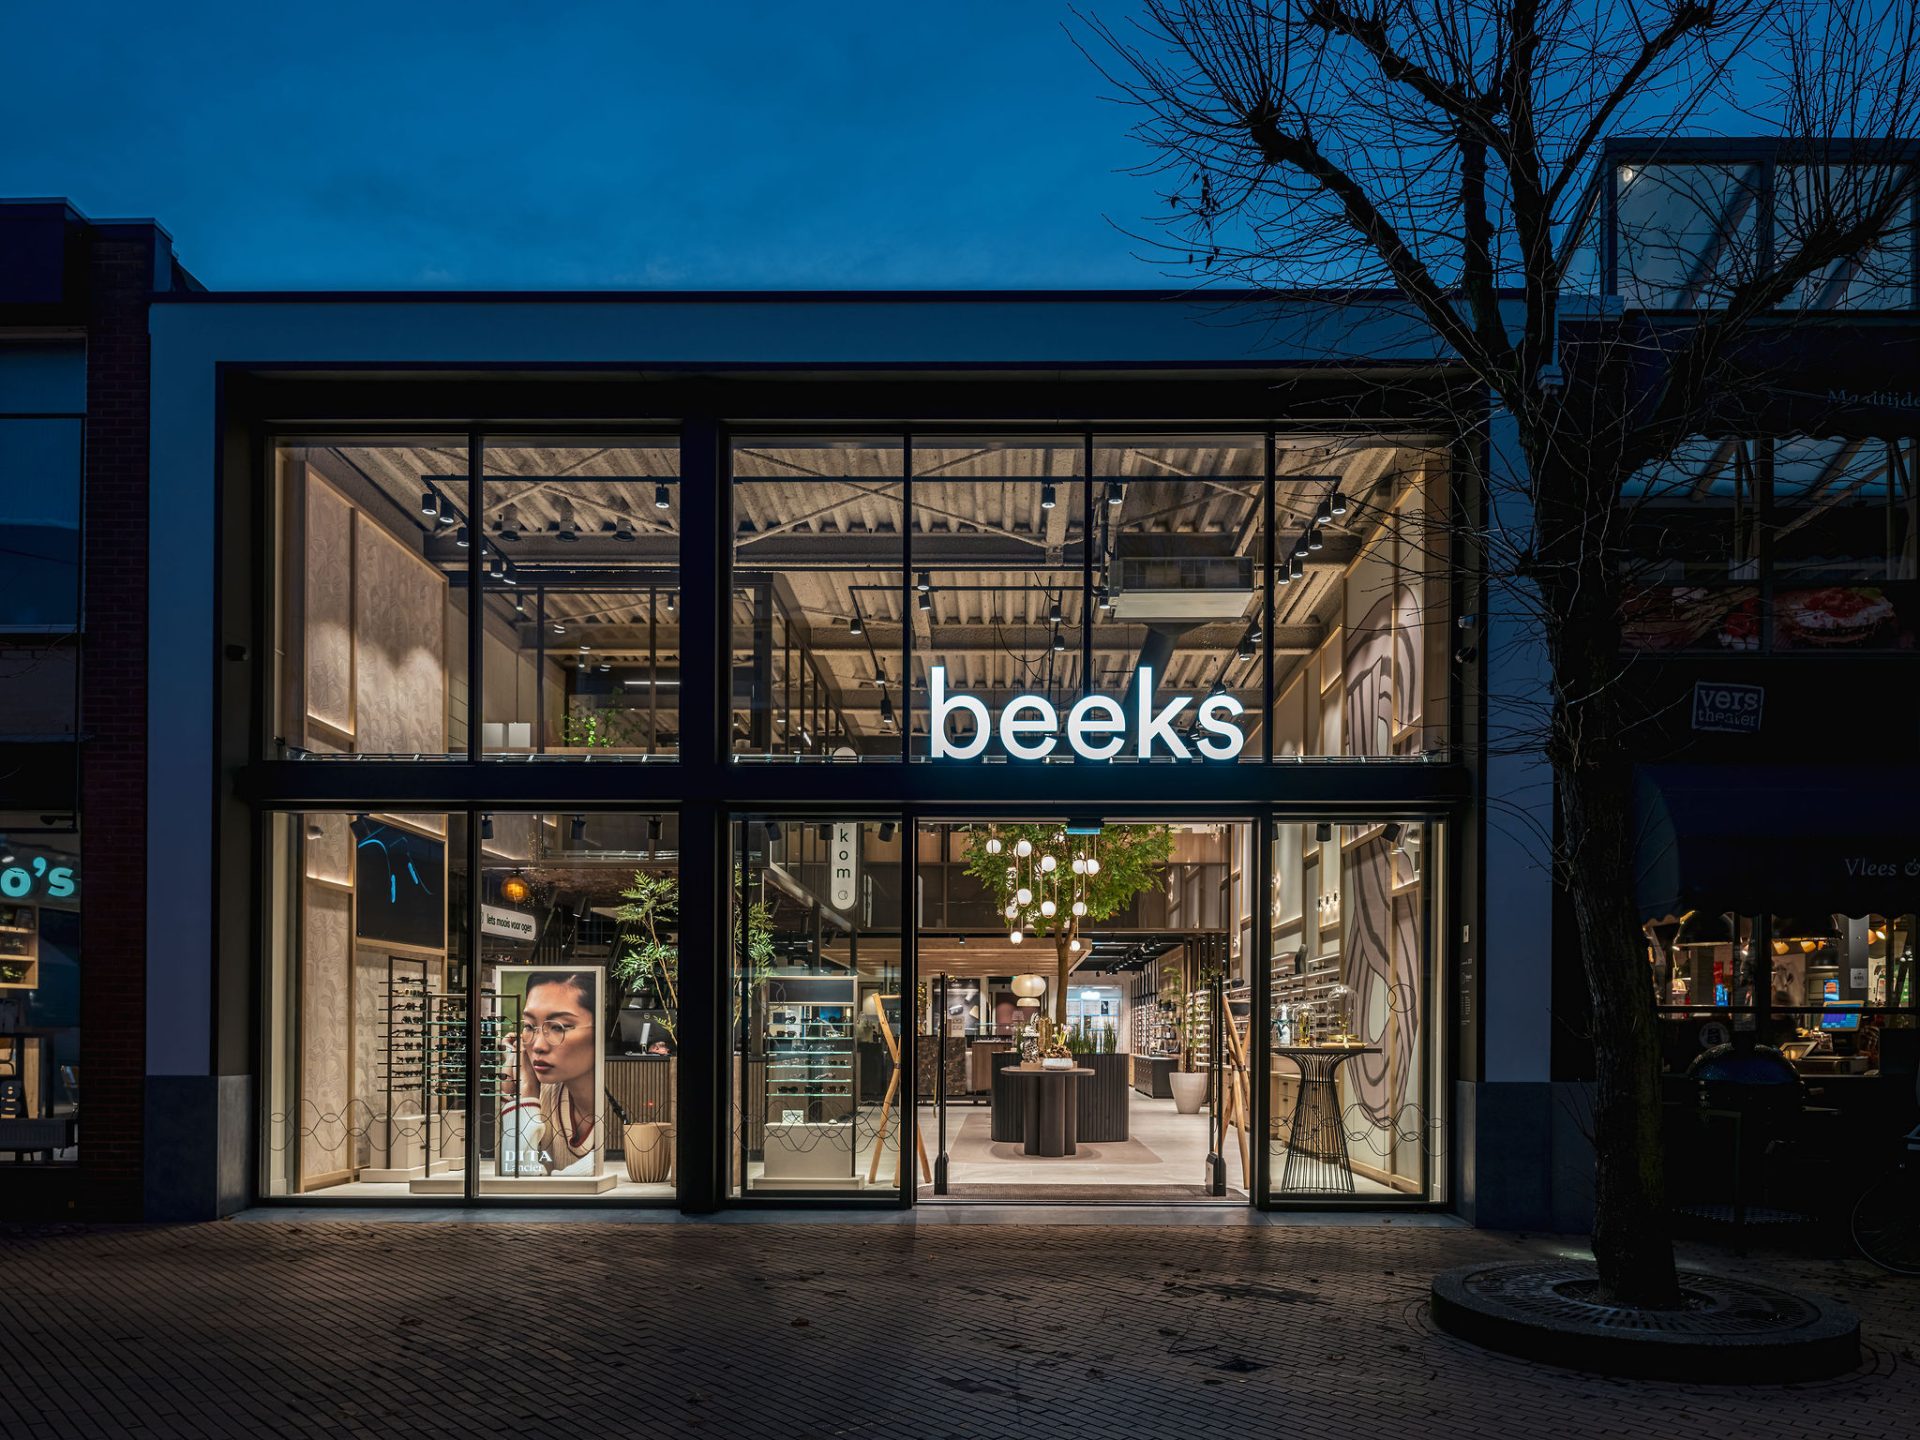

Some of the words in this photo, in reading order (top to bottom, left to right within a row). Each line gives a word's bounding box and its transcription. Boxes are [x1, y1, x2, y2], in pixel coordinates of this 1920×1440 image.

[1699, 690, 1759, 711] vers
[931, 666, 1245, 760] beeks
[1844, 858, 1897, 876] Vlees
[505, 1150, 552, 1162] DITA
